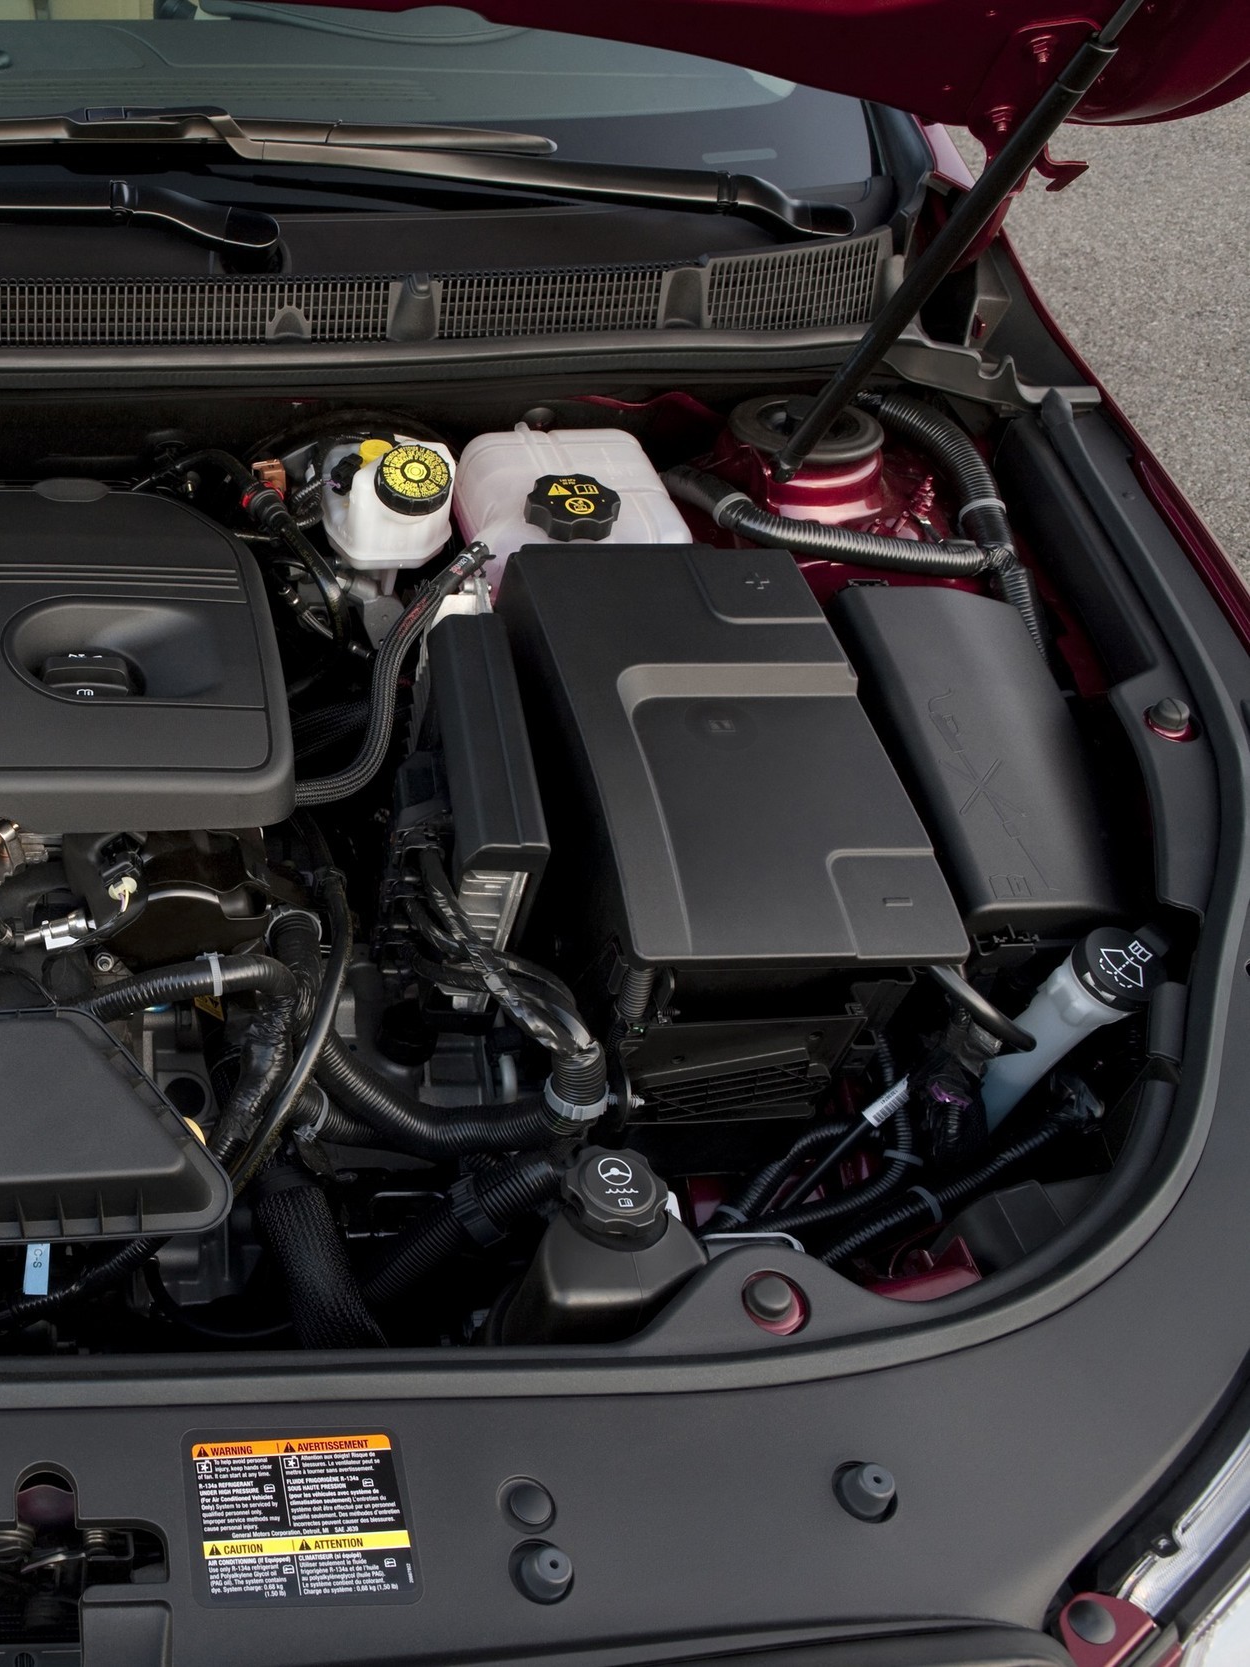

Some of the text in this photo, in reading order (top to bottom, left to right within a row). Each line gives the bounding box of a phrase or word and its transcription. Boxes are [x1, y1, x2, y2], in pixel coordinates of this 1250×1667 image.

[32, 1243, 43, 1269] C-S
[298, 1441, 368, 1451] AVERTISSEMENT
[211, 1447, 253, 1456] WARNING
[224, 1544, 264, 1554] CAUTION
[314, 1539, 364, 1549] ATTENTION
